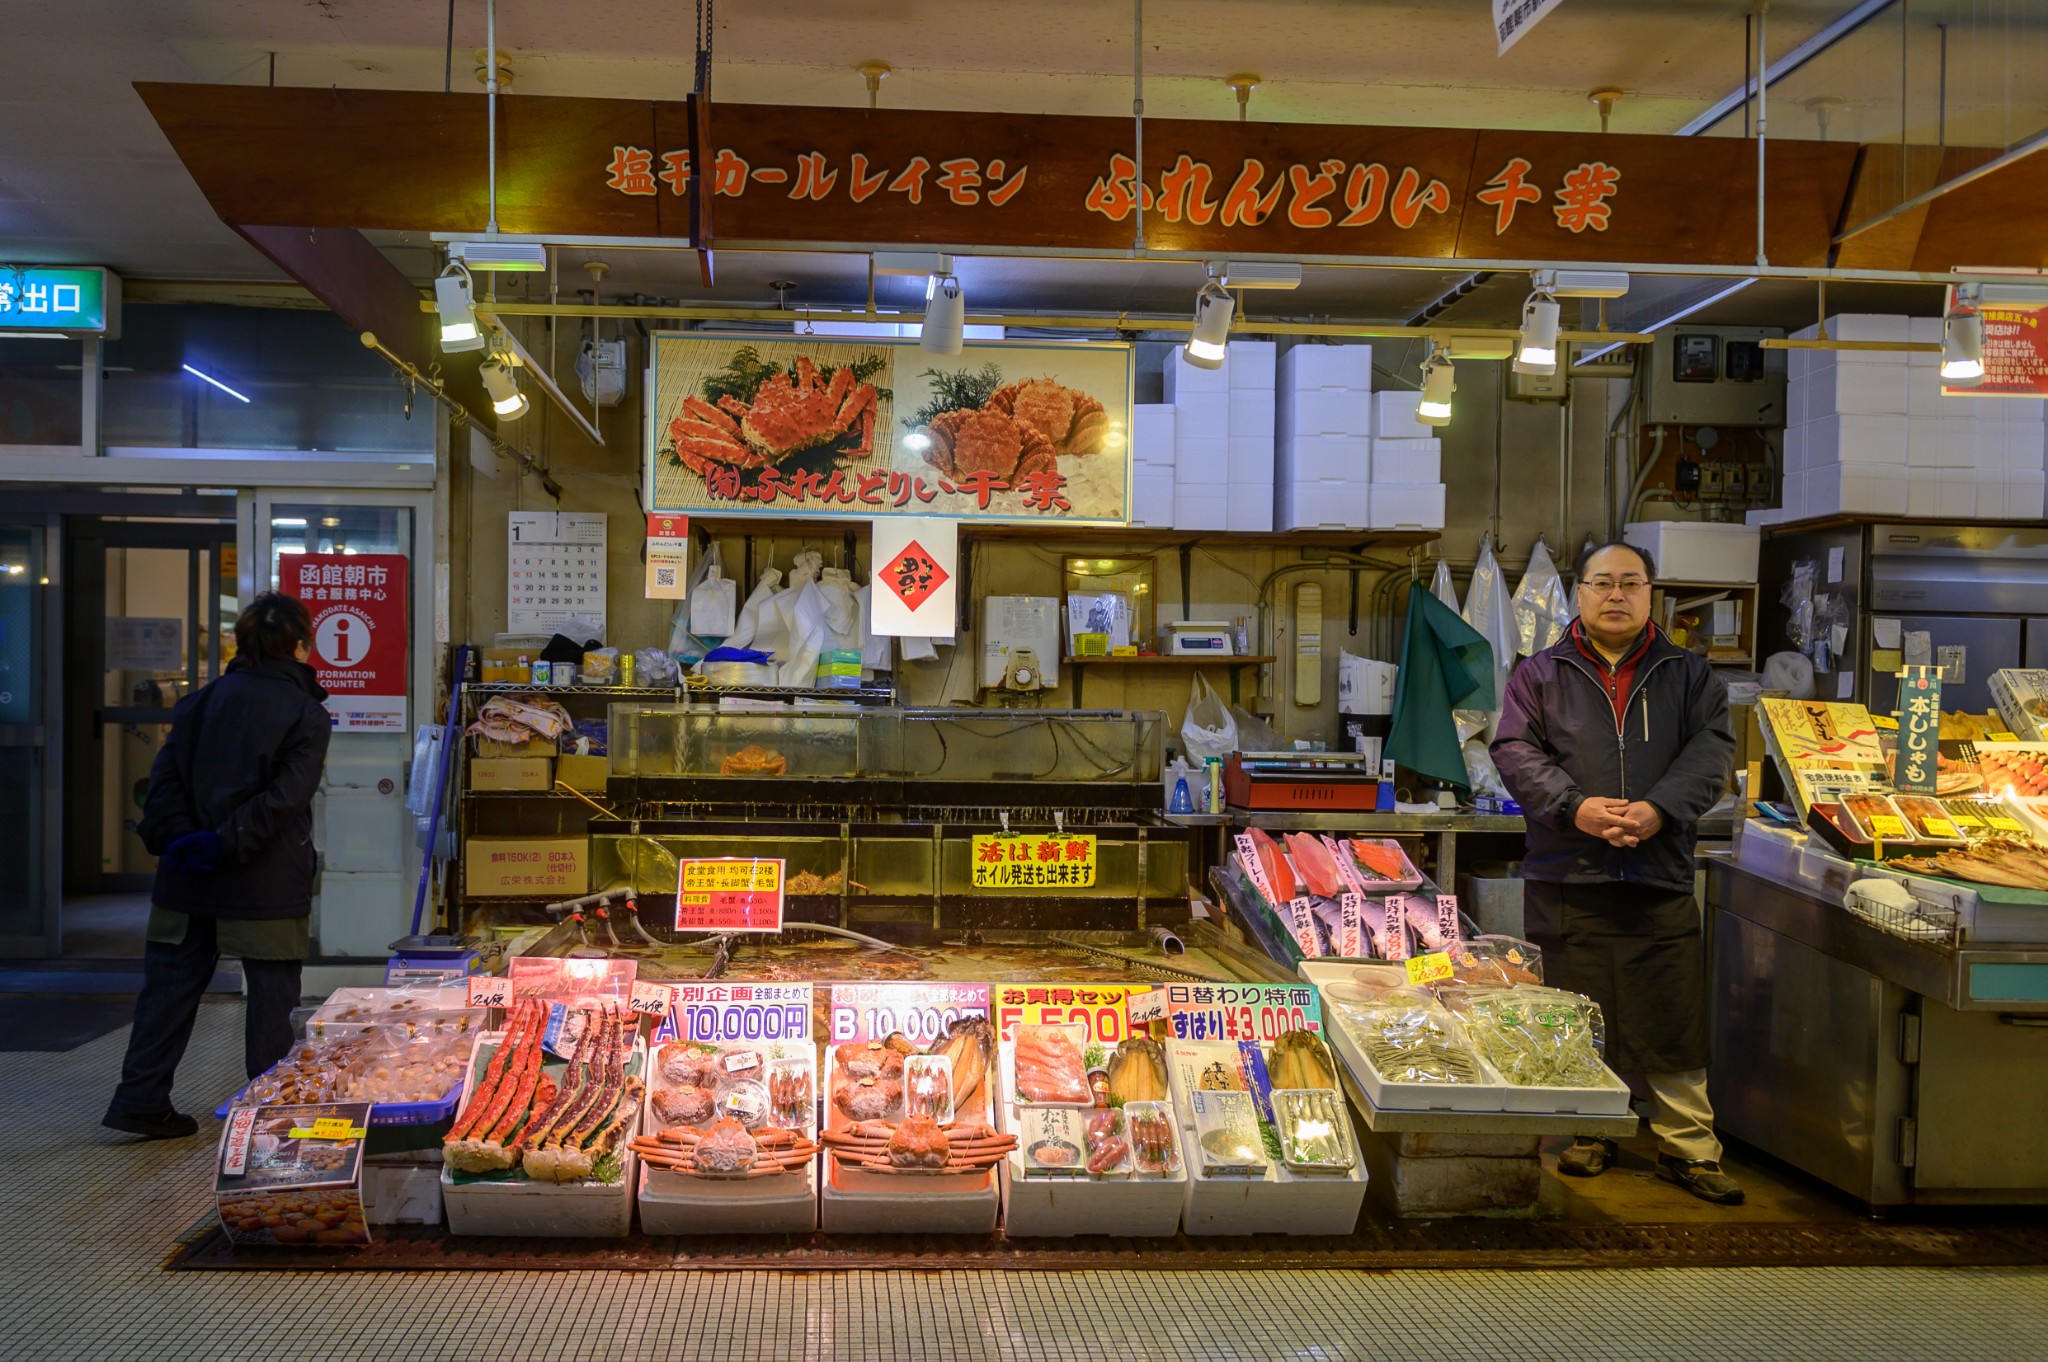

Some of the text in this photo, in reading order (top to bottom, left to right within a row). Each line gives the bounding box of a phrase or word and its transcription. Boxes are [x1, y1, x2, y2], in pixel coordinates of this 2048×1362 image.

[512, 526, 520, 540] 1
[300, 564, 388, 586] 函館朝市
[300, 588, 387, 601] 綜合服務中心
[312, 605, 376, 630] HAKODATE ASAICHI
[317, 670, 376, 679] FORMATION
[320, 680, 366, 688] COUNTER
[1905, 696, 1930, 783] 本ししゃも
[1804, 773, 1863, 782] 宅急便料金表
[978, 840, 1092, 863] 活は新鮮
[687, 866, 726, 875] 食堂食用
[976, 863, 1092, 885] ボイル発送も出来ます
[473, 993, 505, 1006] クール便
[754, 987, 810, 1001] 全部まとめて
[1169, 986, 1311, 1005] 日替わり特価
[631, 998, 664, 1014] クール便
[656, 1004, 807, 1042] A 10,000円
[1131, 1006, 1162, 1024] クール便
[834, 1007, 858, 1041] B
